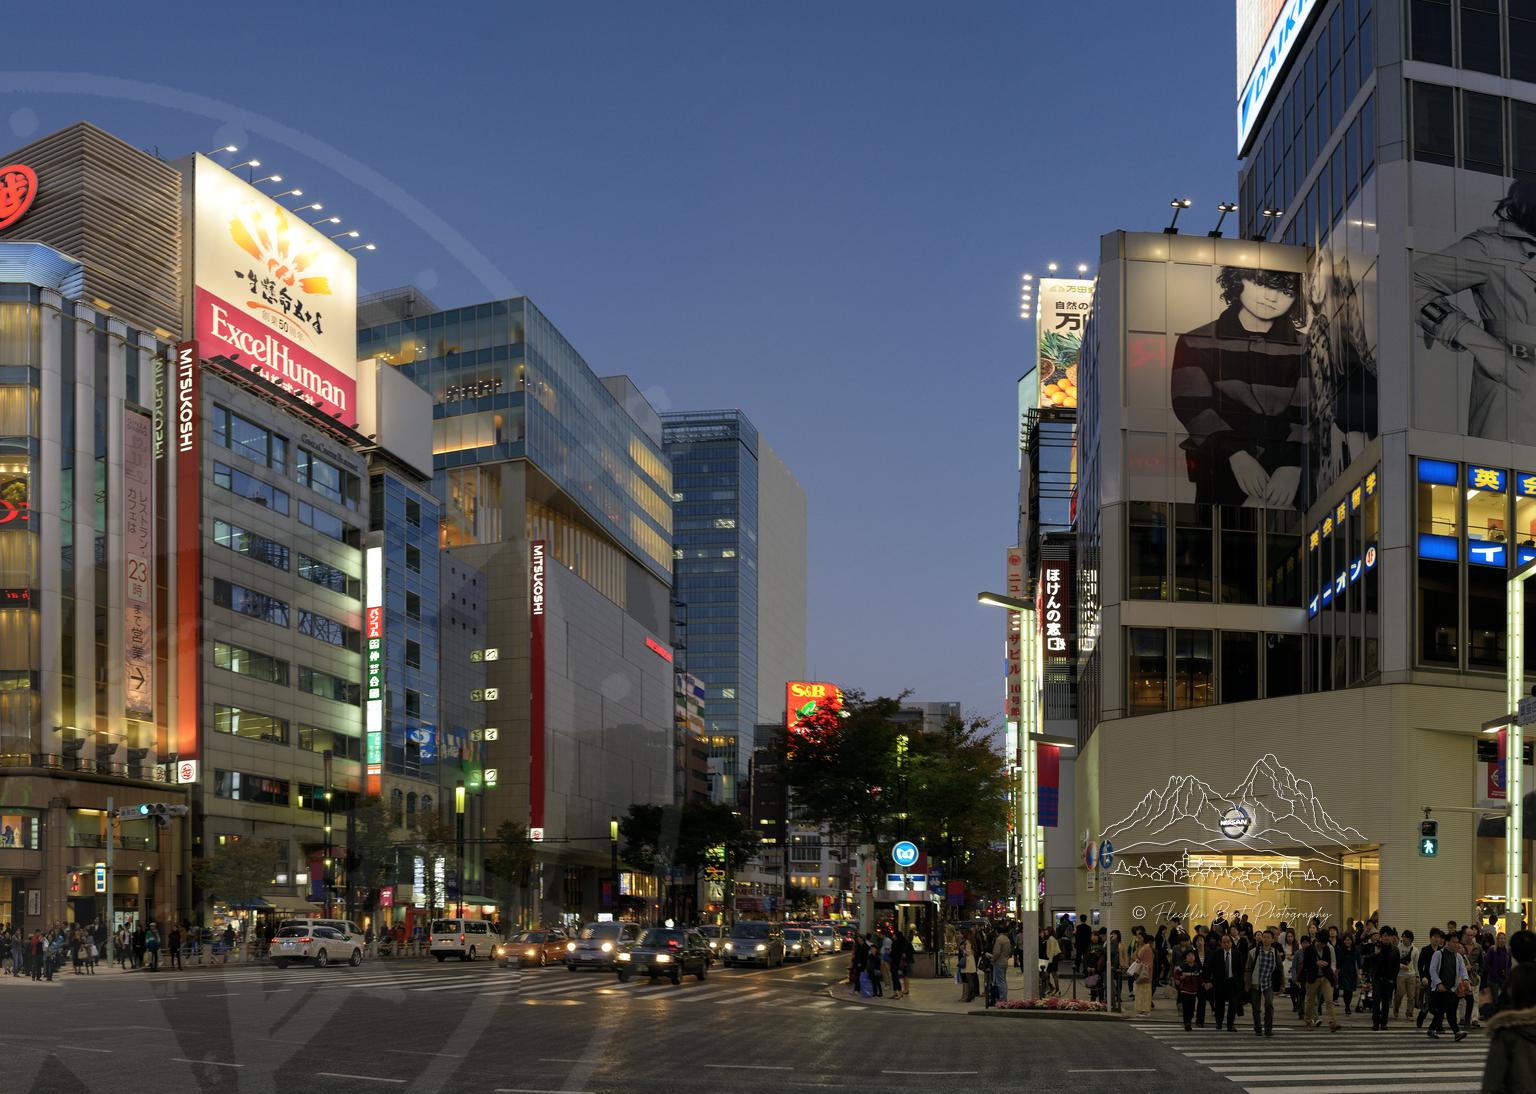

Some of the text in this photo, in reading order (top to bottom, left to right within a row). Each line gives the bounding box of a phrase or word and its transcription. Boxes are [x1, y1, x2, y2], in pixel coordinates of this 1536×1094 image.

[1256, 0, 1307, 102] DAIKI
[1055, 301, 1089, 310] 自然の
[210, 303, 347, 411] ExcelHuman
[179, 348, 193, 452] MITSUKOSHI
[533, 545, 544, 615] MITSUKOSHI
[1310, 560, 1362, 612] イーオン
[791, 683, 825, 698] S&B
[1220, 819, 1247, 827] NISSAN
